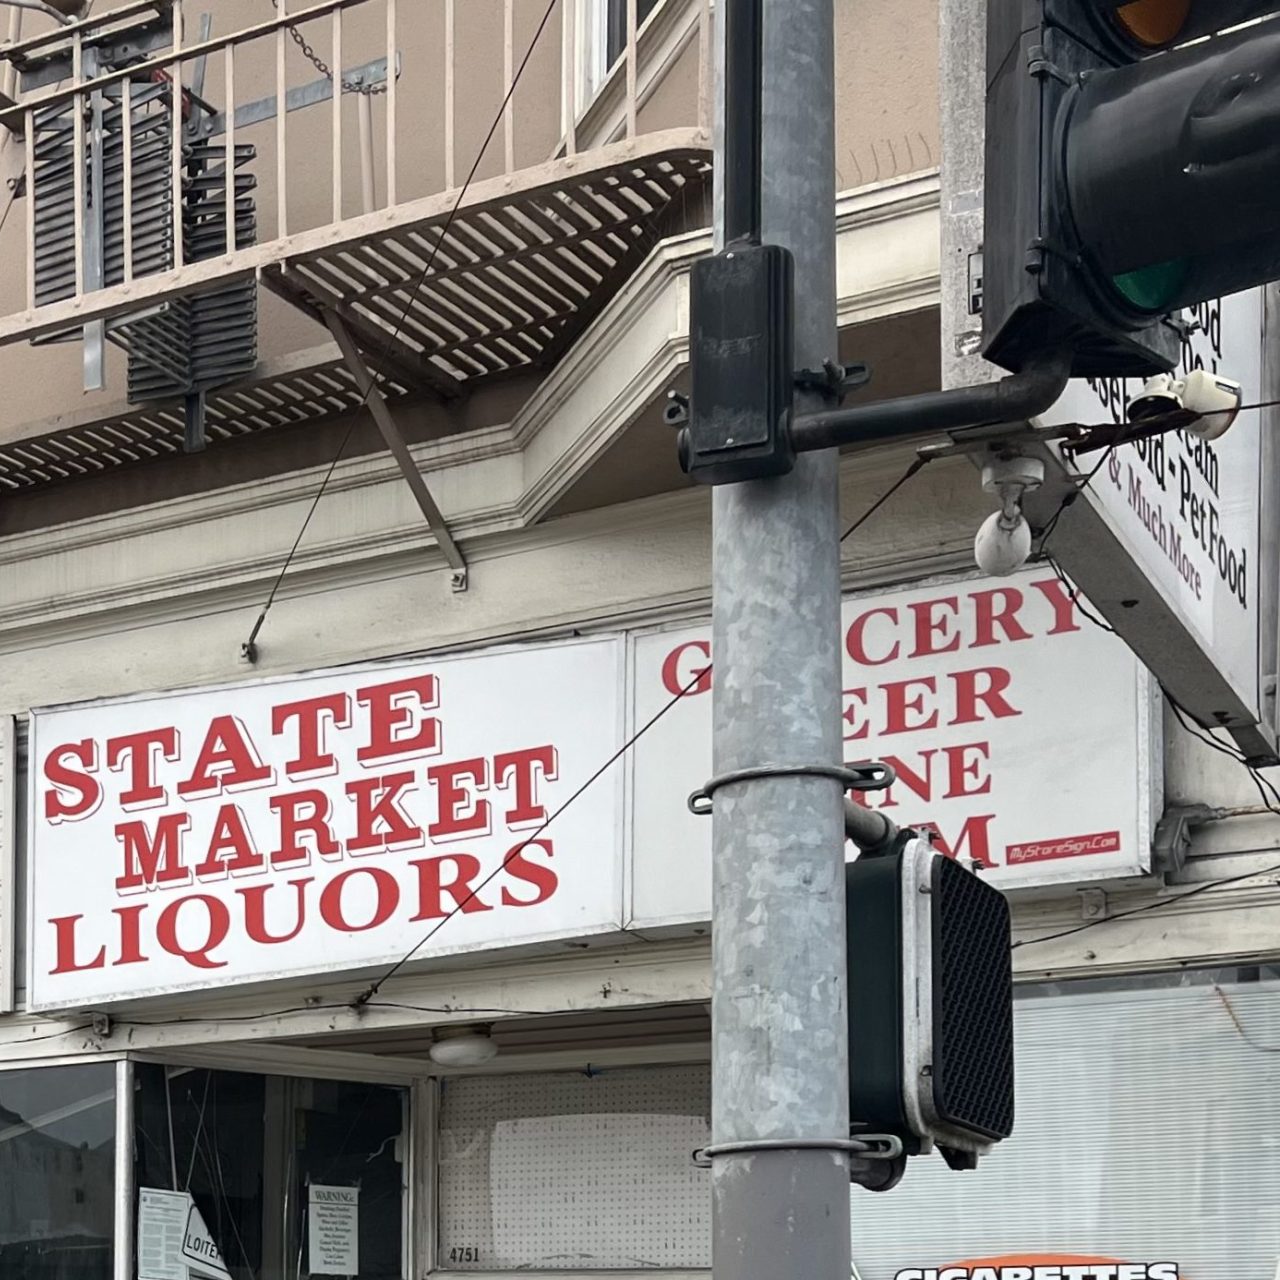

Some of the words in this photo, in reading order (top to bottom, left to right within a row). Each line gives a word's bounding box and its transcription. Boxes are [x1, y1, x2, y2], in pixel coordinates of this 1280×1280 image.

[1108, 447, 1122, 490] &
[1127, 463, 1168, 556] Much
[1169, 521, 1202, 602] More
[661, 576, 1082, 697] GCERY
[43, 673, 442, 824] STATE
[114, 744, 559, 897] MARKET
[1010, 836, 1117, 861] MyStoreSign.Com
[48, 838, 559, 975] LIQUORS
[449, 1247, 480, 1262] 4751
